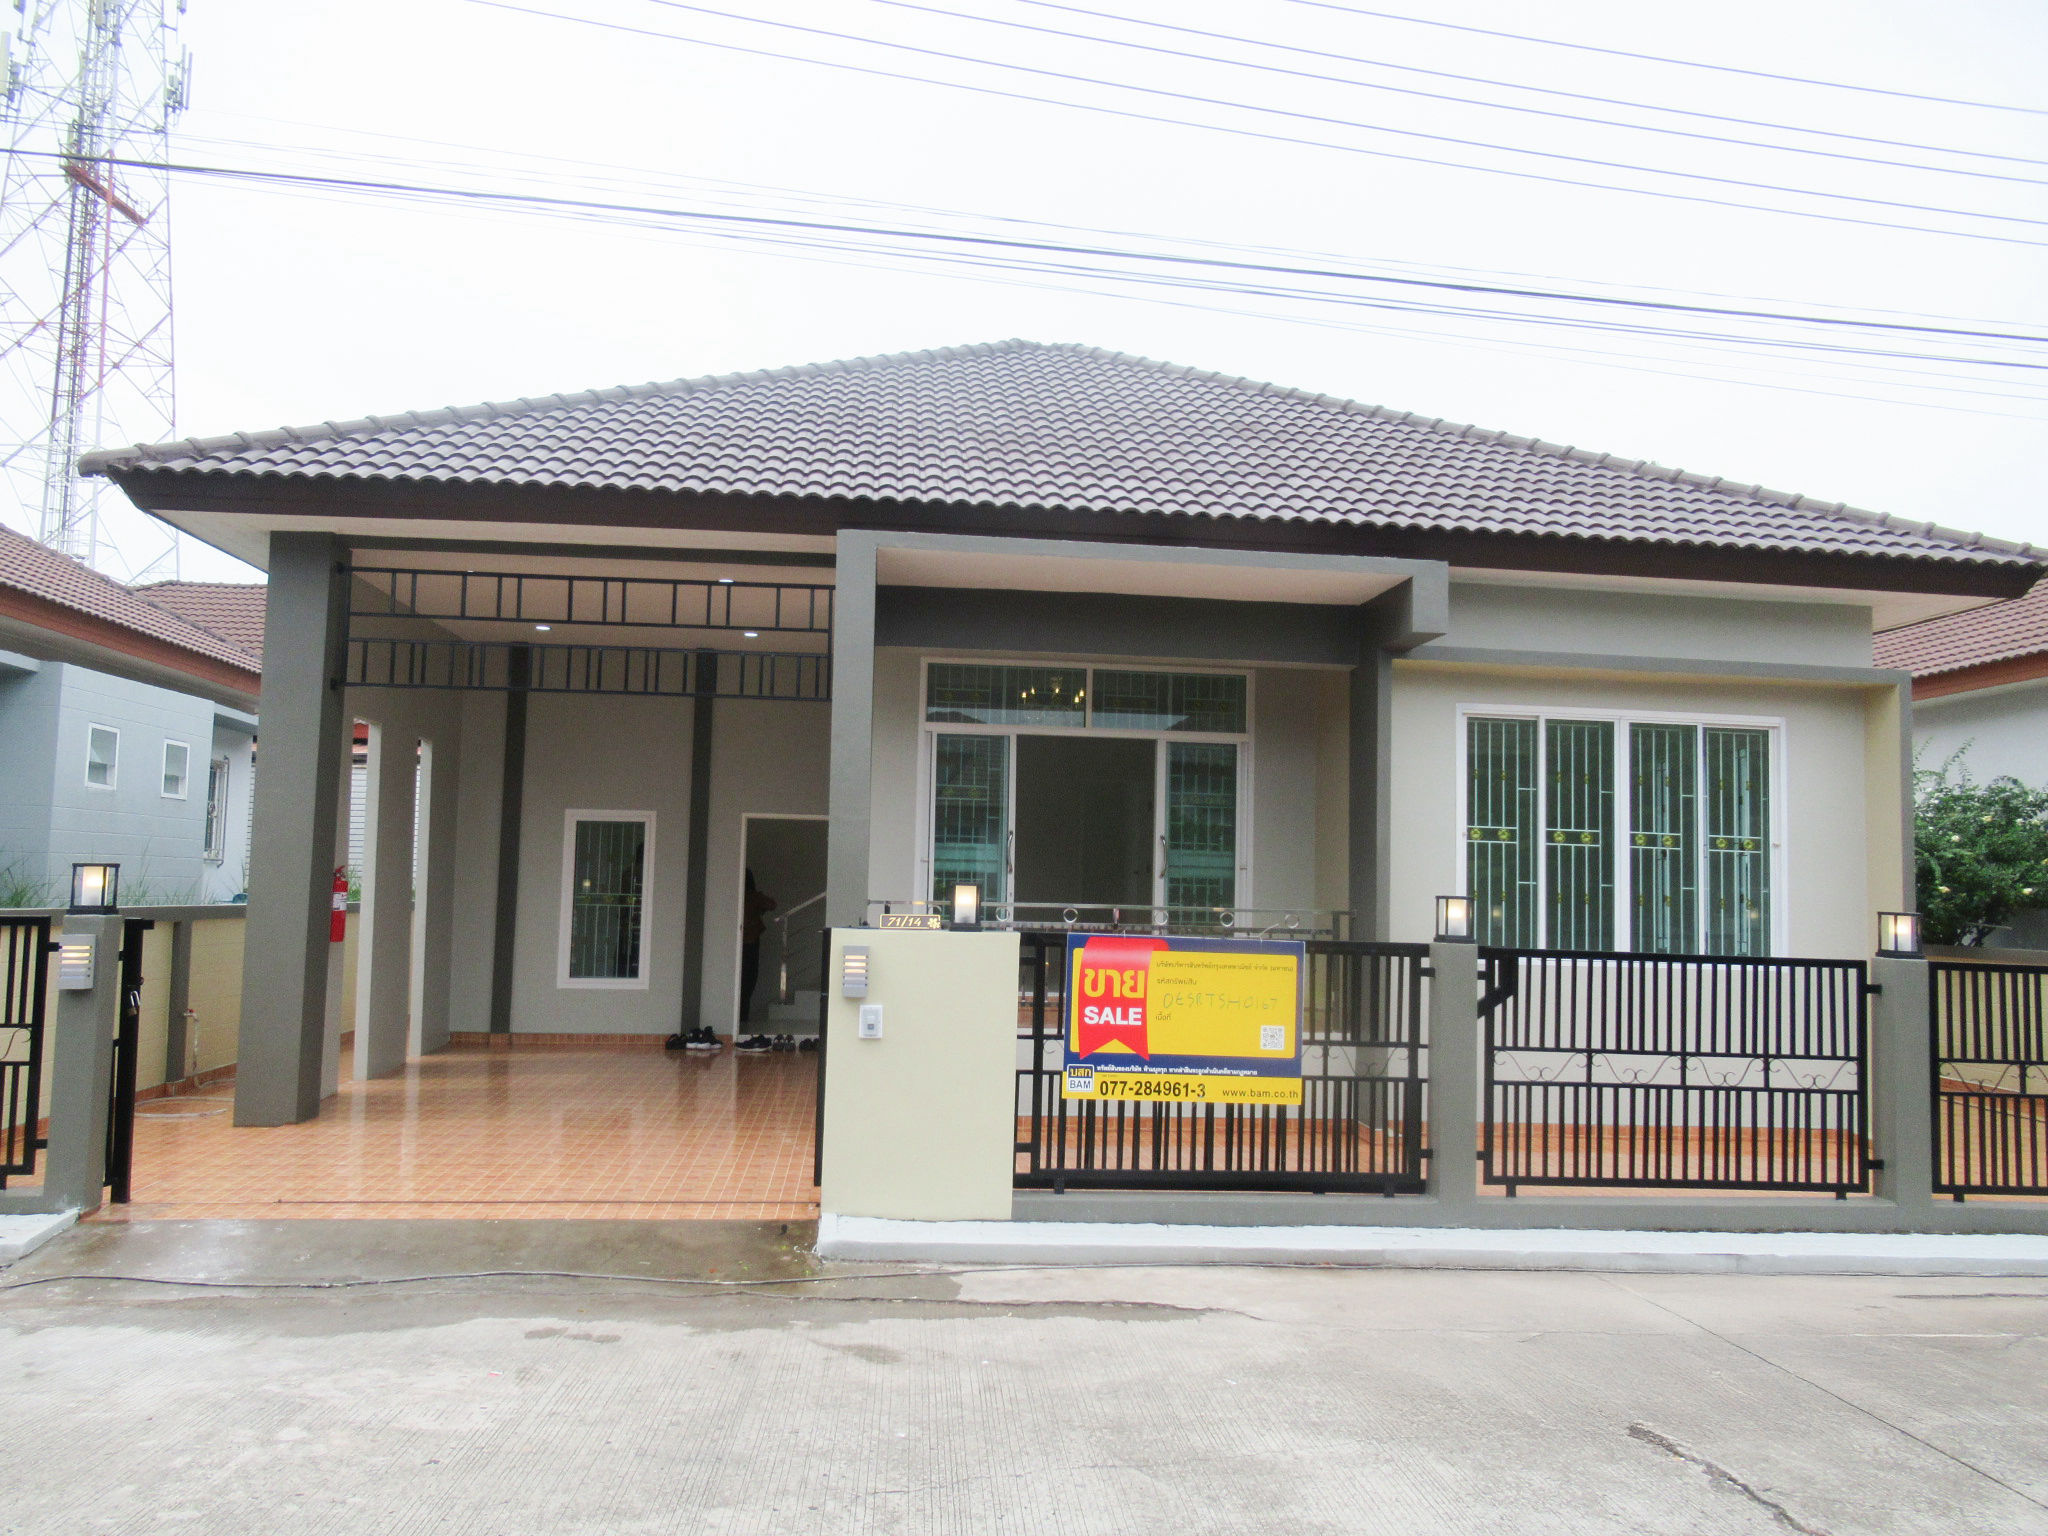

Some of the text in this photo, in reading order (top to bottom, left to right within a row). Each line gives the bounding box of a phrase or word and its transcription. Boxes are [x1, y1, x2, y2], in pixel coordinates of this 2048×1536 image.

[887, 916, 921, 927] 71/14
[1083, 968, 1145, 999] ขาย
[1083, 1006, 1143, 1026] SALE
[1070, 1067, 1091, 1077] บสก
[1069, 1080, 1091, 1089] BAM
[1099, 1080, 1206, 1098] 077-284961-3
[1222, 1088, 1299, 1099] www.bam.co.th
